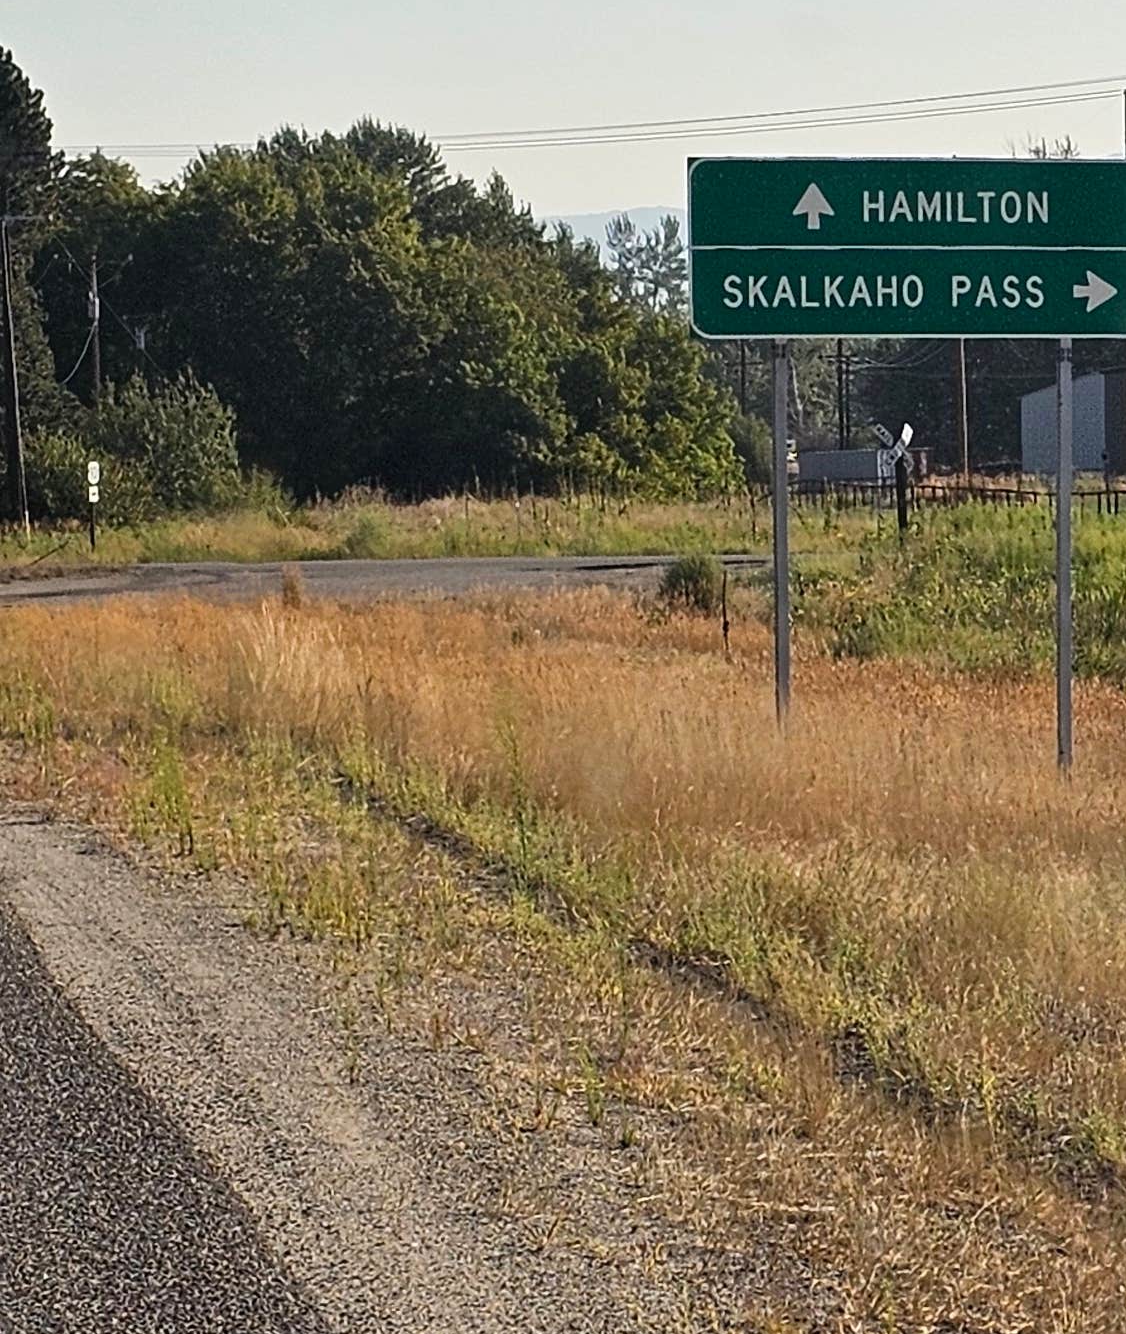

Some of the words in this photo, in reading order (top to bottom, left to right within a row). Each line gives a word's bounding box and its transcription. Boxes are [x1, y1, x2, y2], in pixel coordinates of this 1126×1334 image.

[864, 189, 1049, 224] HAMILTON
[723, 274, 924, 309] SKALKAHO
[951, 275, 1045, 309] PASS
